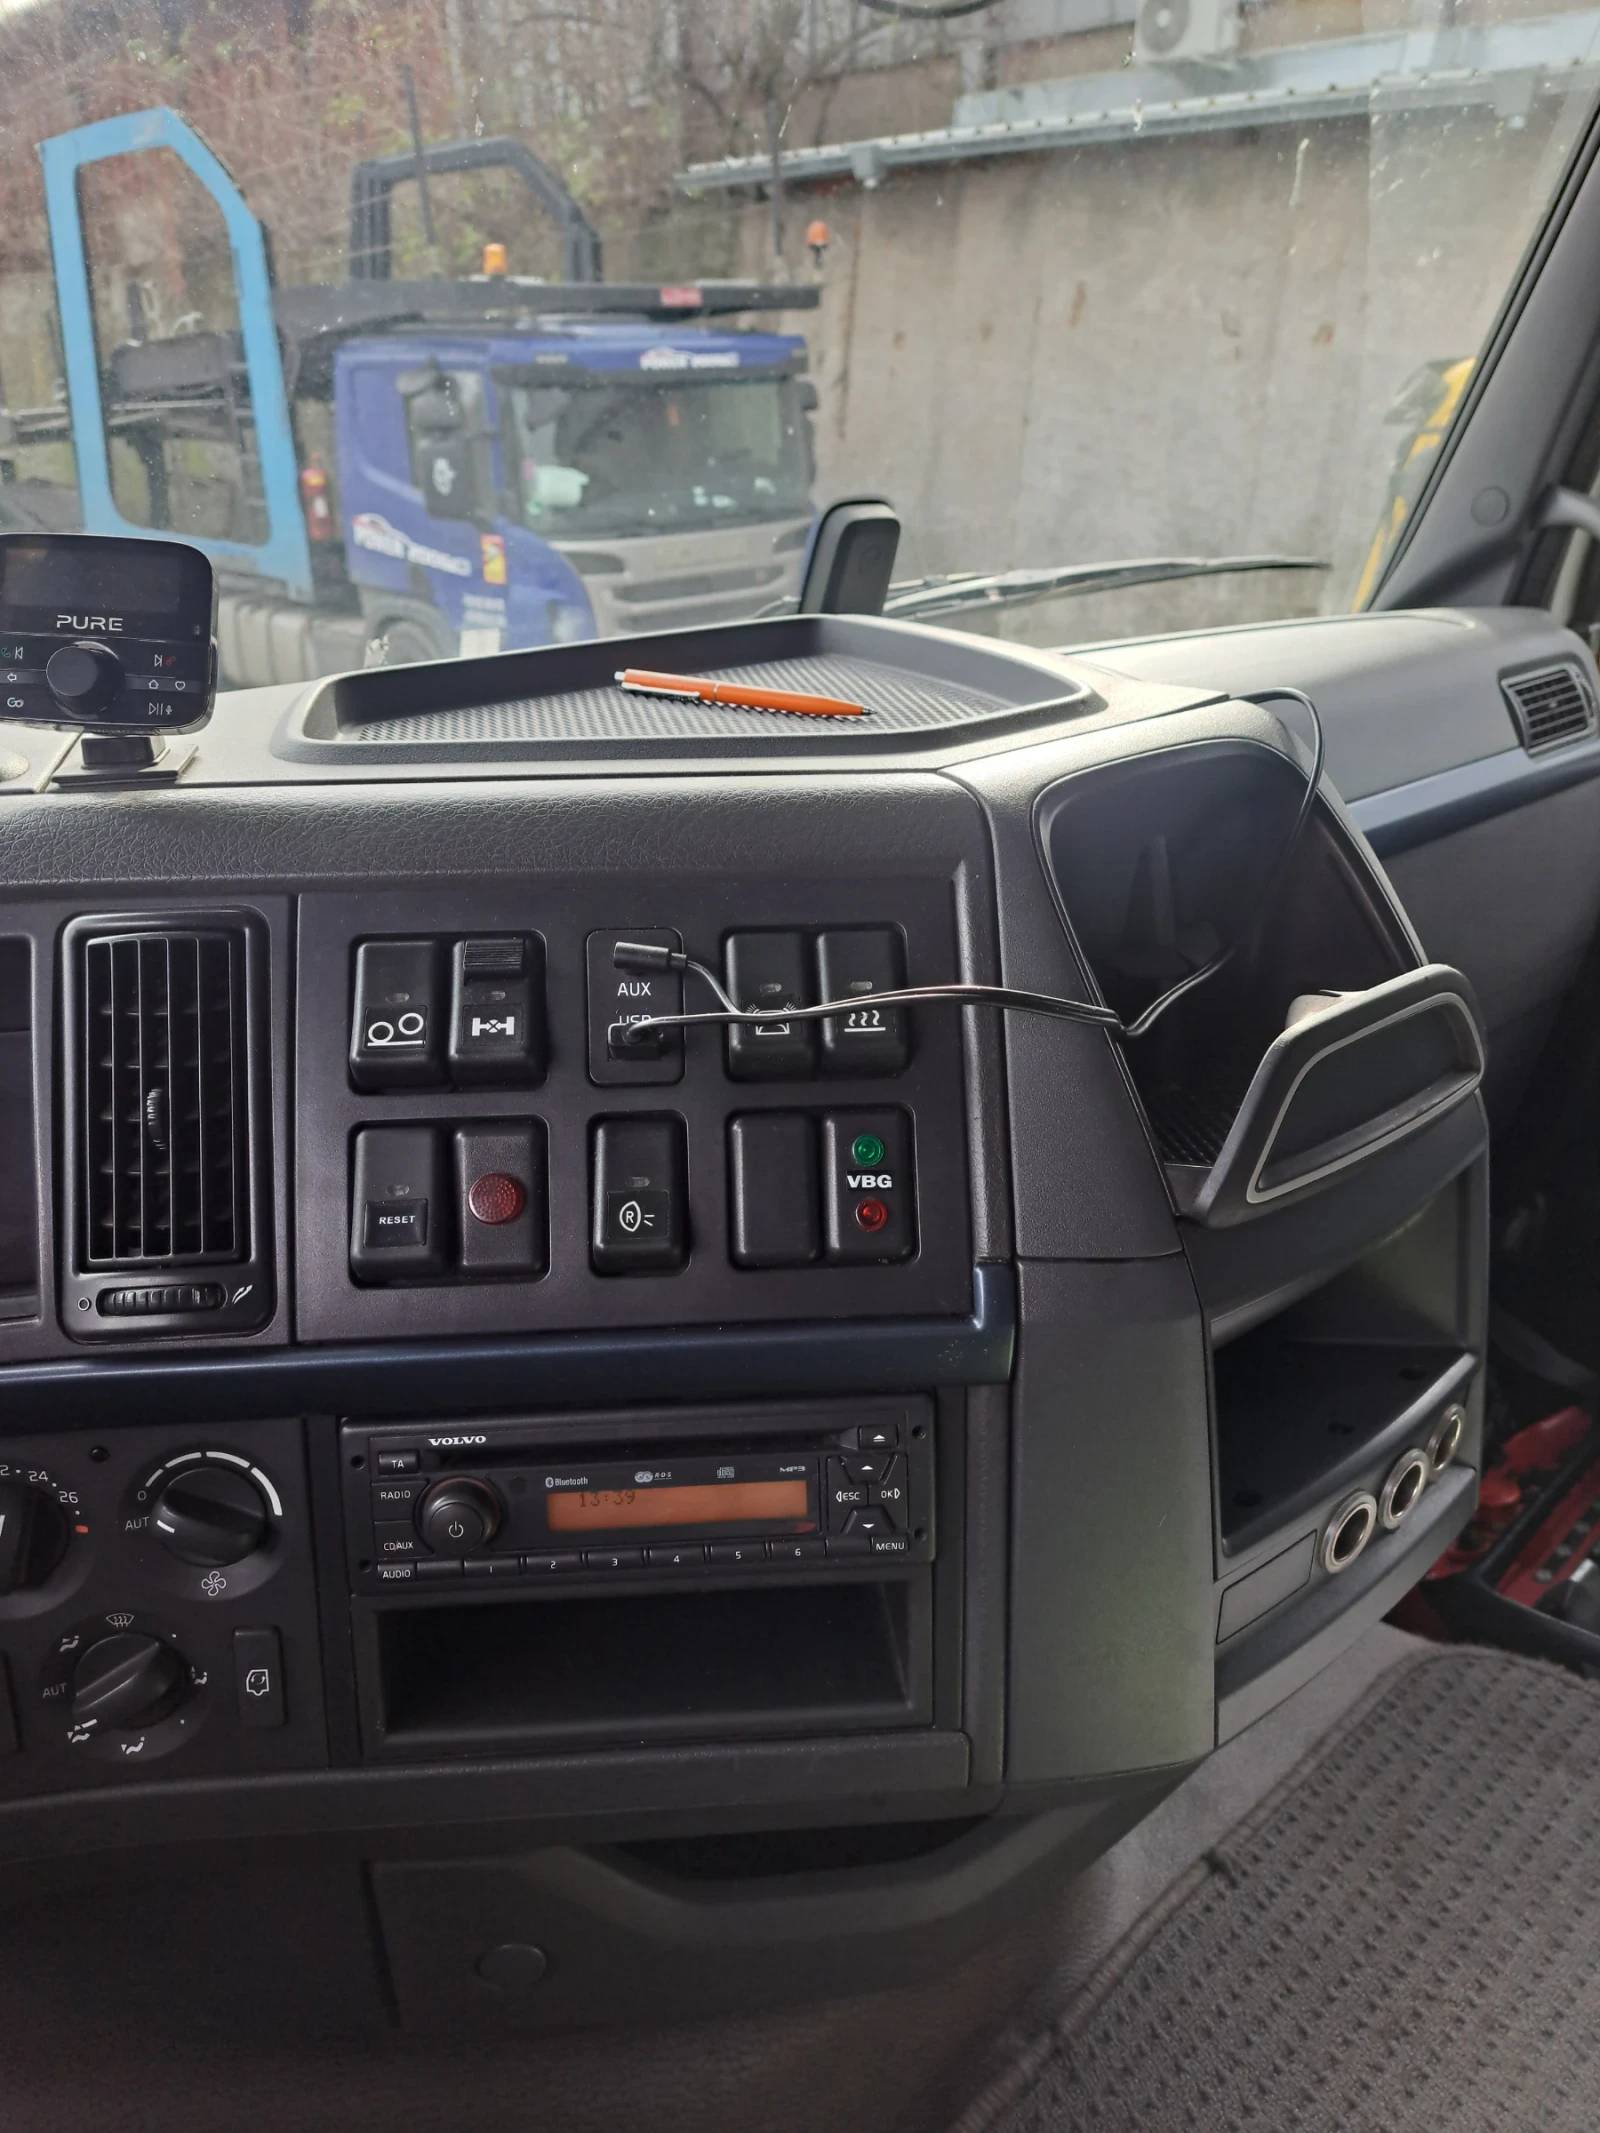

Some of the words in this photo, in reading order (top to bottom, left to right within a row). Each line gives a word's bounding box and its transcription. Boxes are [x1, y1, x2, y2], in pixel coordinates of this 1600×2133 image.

[56, 614, 123, 631] PURE
[617, 982, 652, 996] AUX
[846, 1174, 893, 1189] VBG
[379, 1215, 416, 1225] RESET
[428, 1435, 487, 1446] VOLVO
[391, 1460, 405, 1469] TA
[779, 1465, 806, 1473] MP3
[28, 1470, 48, 1482] 24
[554, 1477, 589, 1487] Bluetooth
[59, 1490, 79, 1504] 26
[380, 1490, 411, 1500] RADIO
[842, 1491, 861, 1501] ESC
[881, 1489, 894, 1499] OK
[580, 1491, 636, 1508] 13:39
[124, 1516, 150, 1531] AUT
[383, 1541, 414, 1551] CD/AUX
[875, 1542, 905, 1551] MENU
[735, 1551, 742, 1560] 5
[794, 1548, 801, 1557] 6
[612, 1557, 618, 1567] 3
[673, 1554, 680, 1564] 4
[550, 1560, 556, 1569] 2
[382, 1570, 411, 1579] AUDIO
[42, 1682, 67, 1698] AUT
